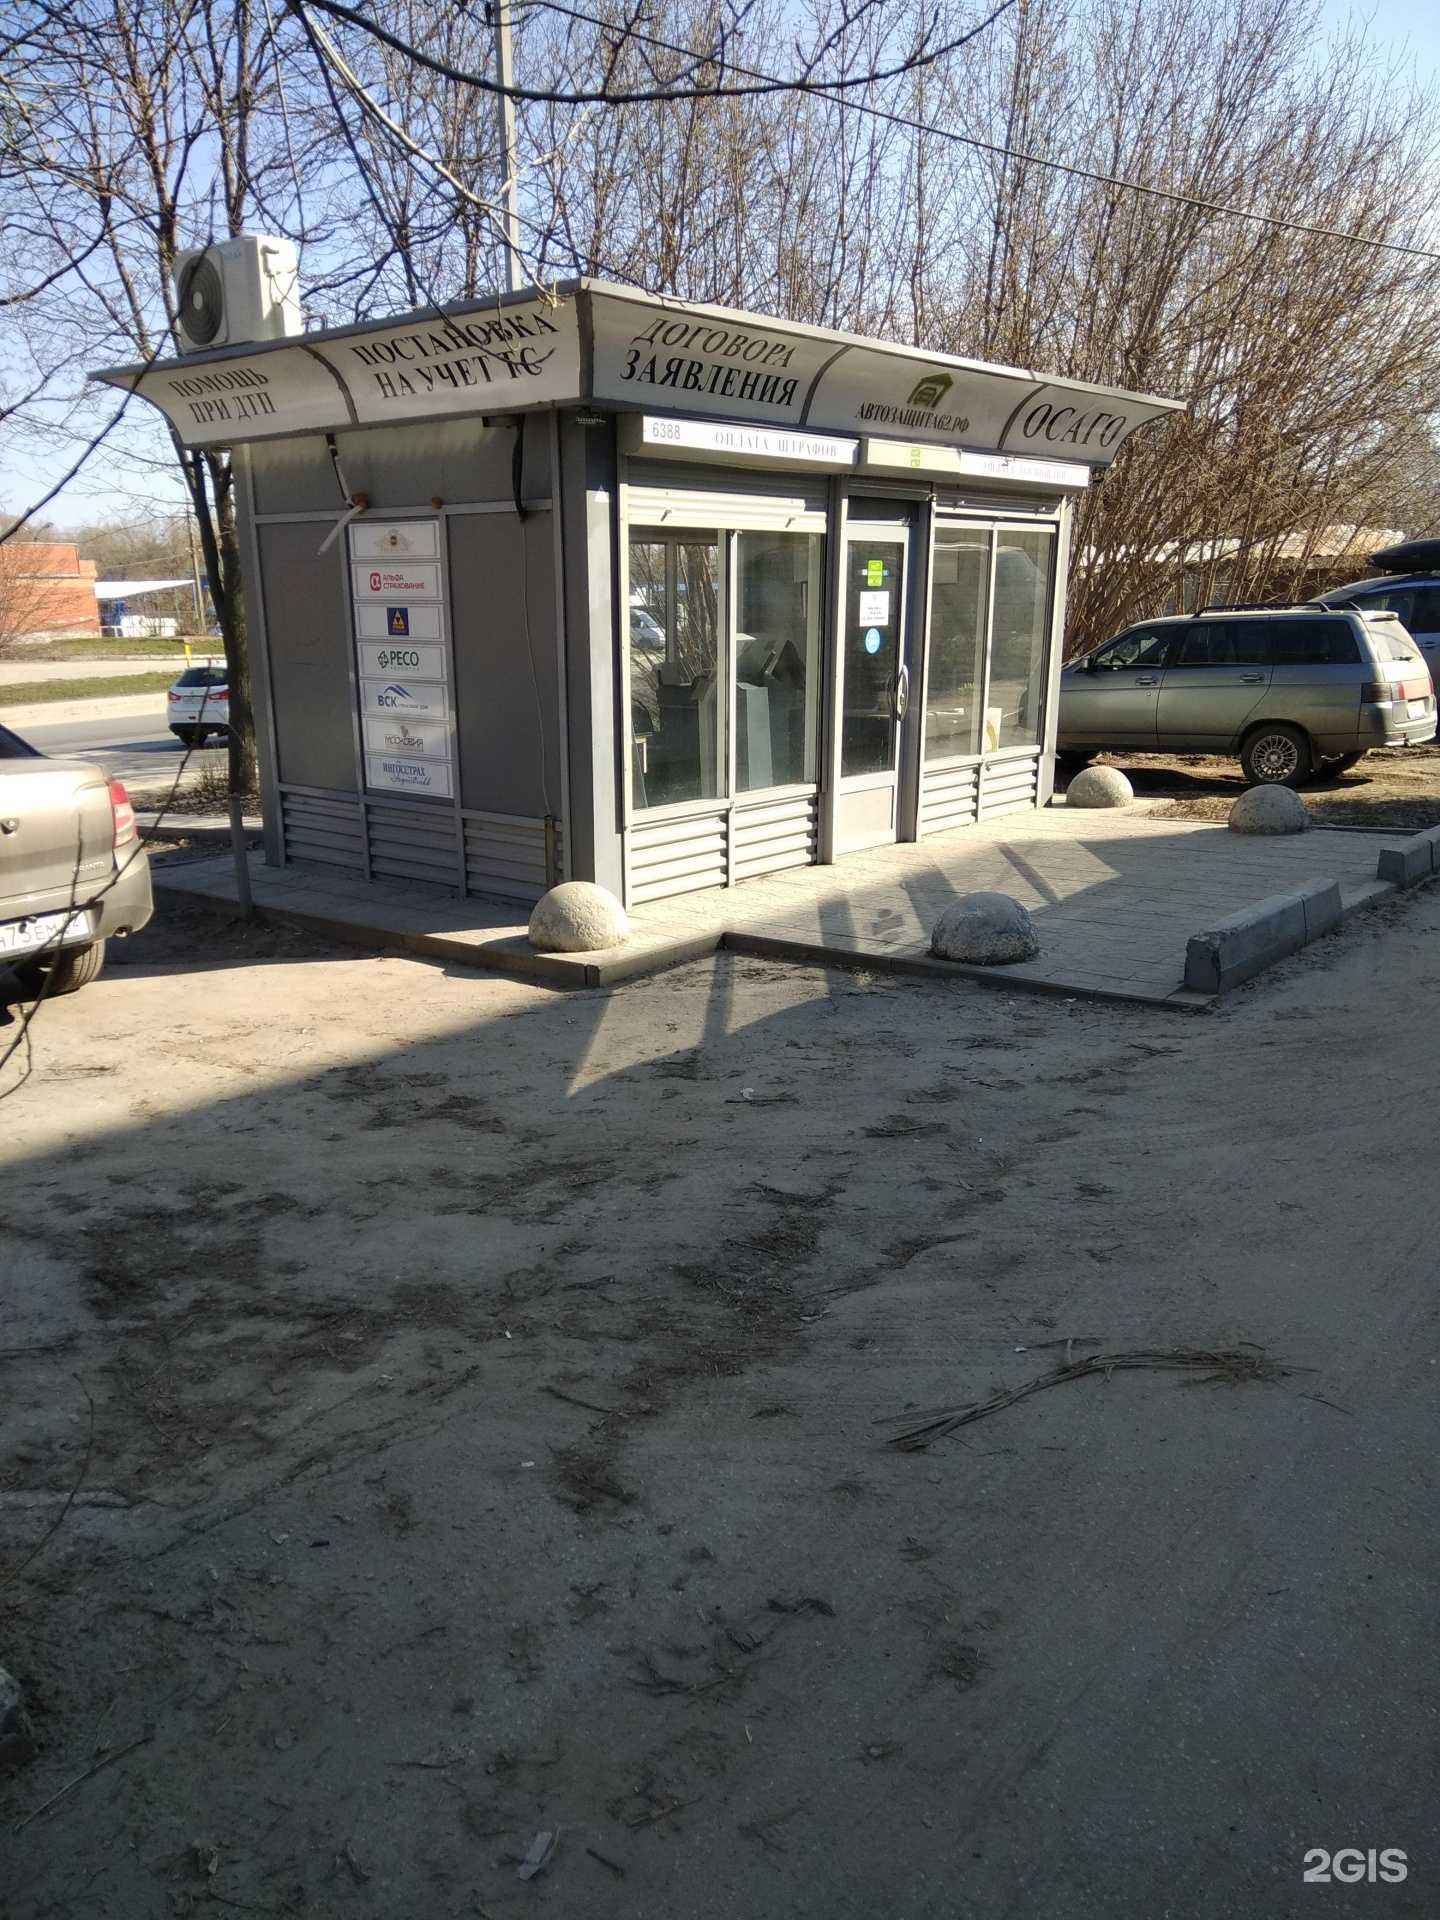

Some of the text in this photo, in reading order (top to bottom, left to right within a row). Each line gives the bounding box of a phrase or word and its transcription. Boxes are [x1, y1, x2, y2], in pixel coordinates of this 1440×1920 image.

[351, 312, 559, 366] ПОСТАНОВКА
[630, 318, 796, 367] ДОГОВОРА
[168, 368, 269, 398] ПОМОЩЬ
[374, 346, 543, 398] НА УЧЕТ ТС
[620, 349, 799, 406] ЗАЯВЛЕНИЯ
[188, 391, 276, 424] ПРИ ДТП
[1023, 403, 1127, 448] ОСАГО
[389, 650, 419, 667] РЕСО
[378, 695, 398, 708] ВСК
